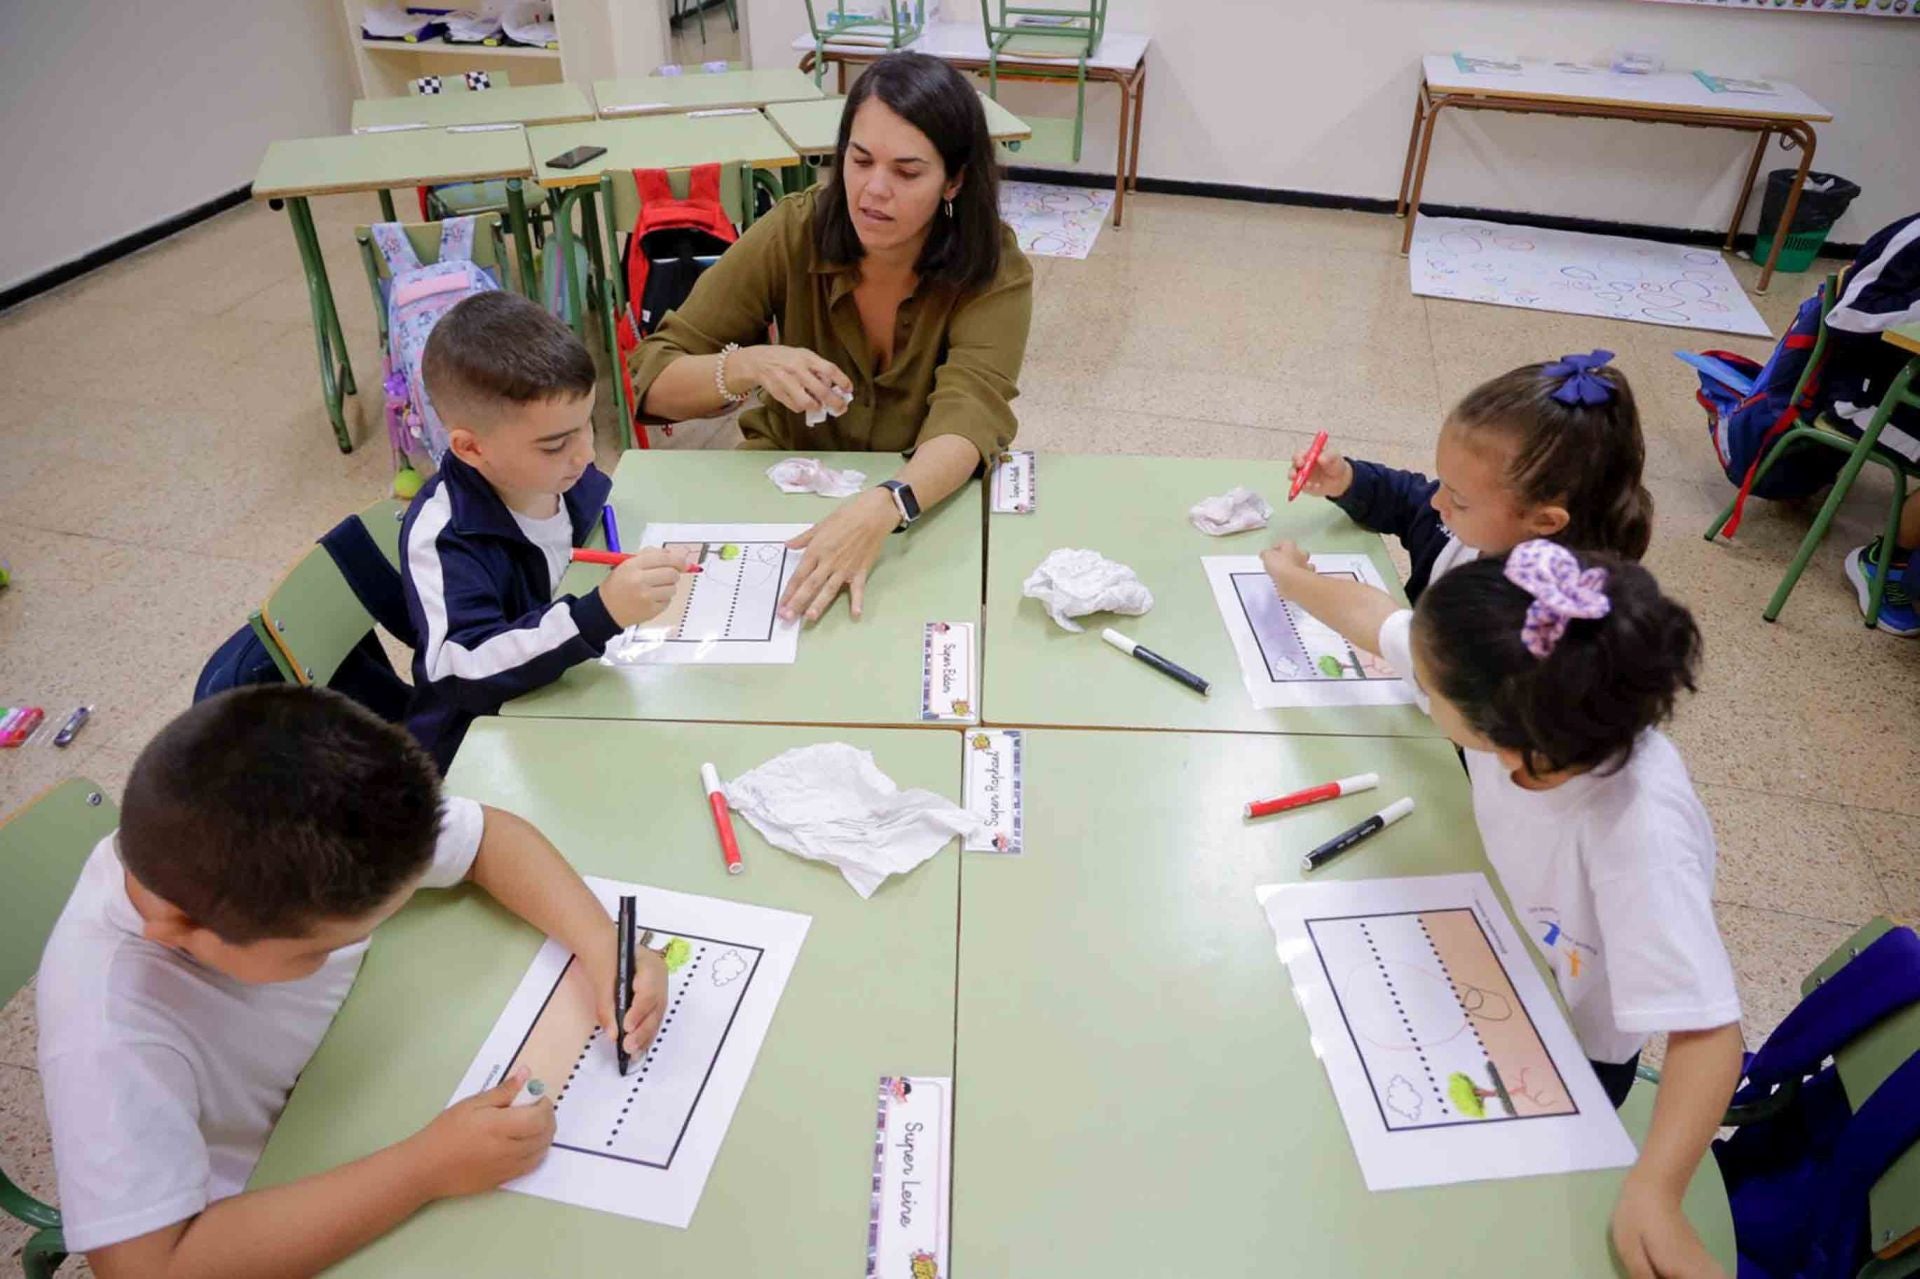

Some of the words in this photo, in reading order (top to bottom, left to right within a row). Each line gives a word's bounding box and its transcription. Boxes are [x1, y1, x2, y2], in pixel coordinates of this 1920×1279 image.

[936, 643, 957, 667] Super
[984, 750, 1006, 791] Raphael
[984, 793, 1006, 827] Super
[895, 1121, 924, 1176] Super
